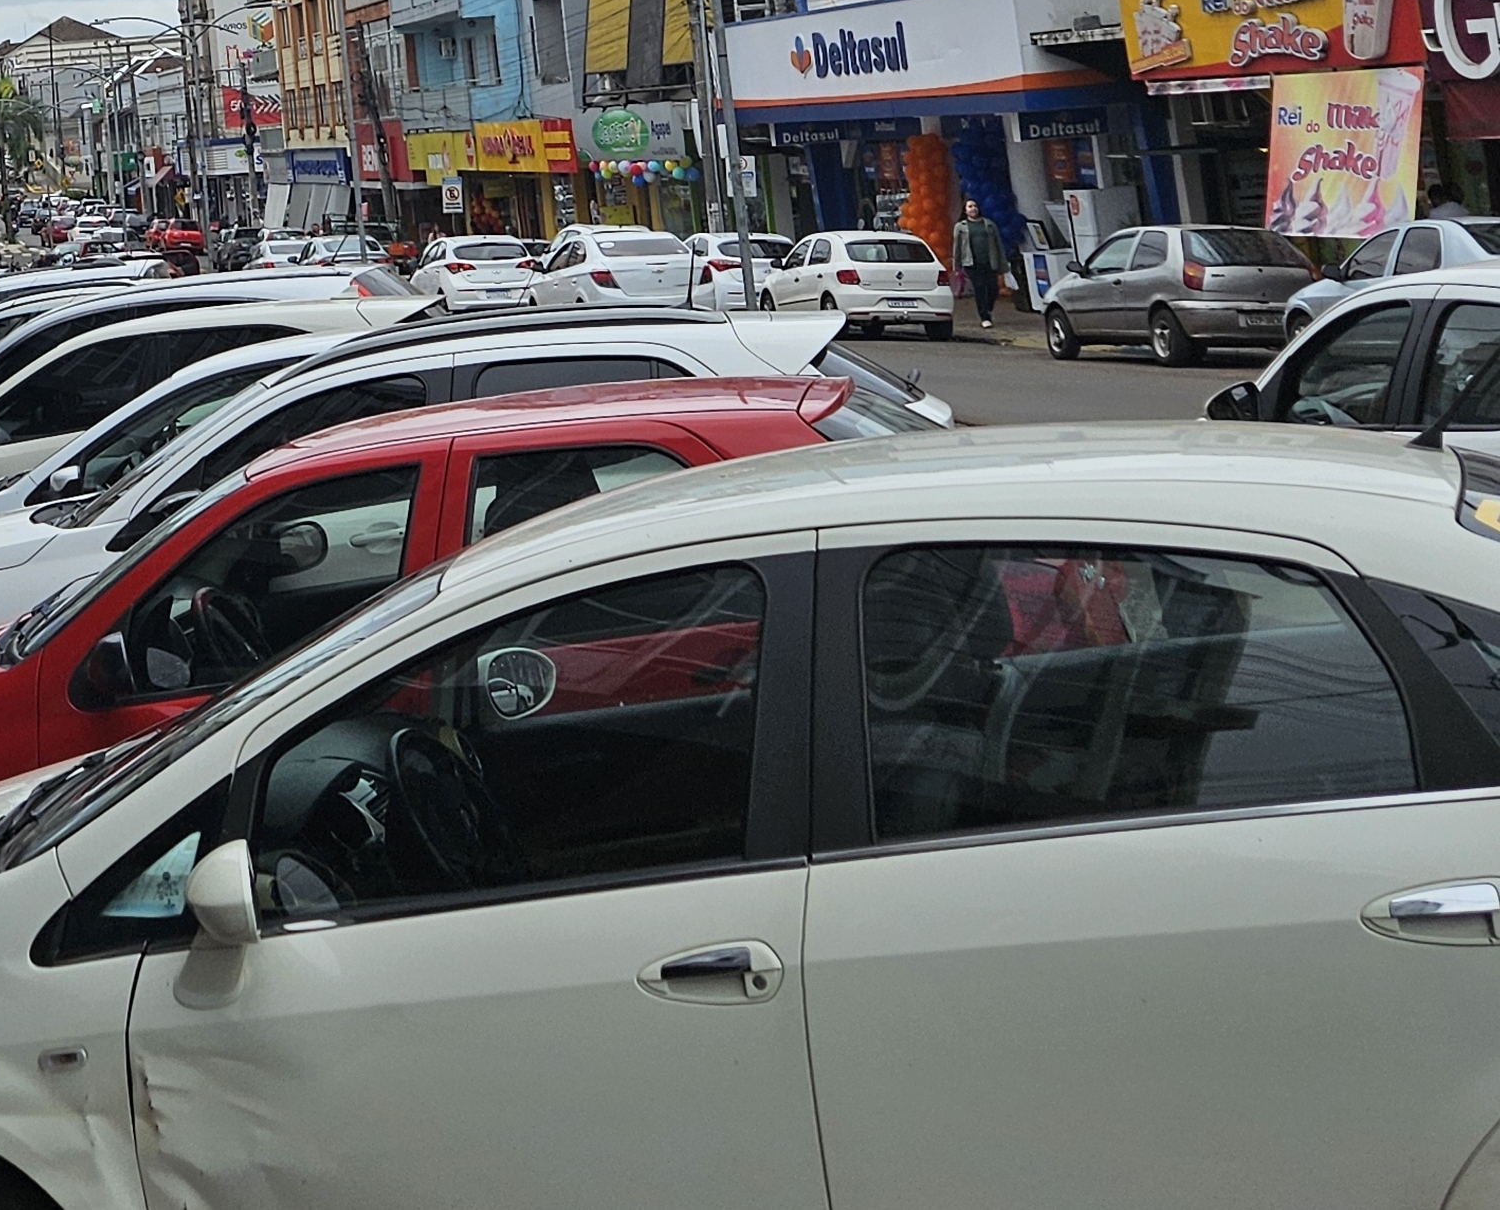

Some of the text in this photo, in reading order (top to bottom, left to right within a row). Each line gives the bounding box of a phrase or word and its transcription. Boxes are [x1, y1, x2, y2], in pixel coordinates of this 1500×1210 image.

[812, 21, 909, 78] Deltasul
[1230, 13, 1323, 66] Shake
[782, 128, 839, 143] Deltasul
[1029, 118, 1100, 138] Deltasul
[1278, 106, 1302, 125] Rei
[1306, 119, 1320, 133] do
[1291, 141, 1378, 181] Shake
